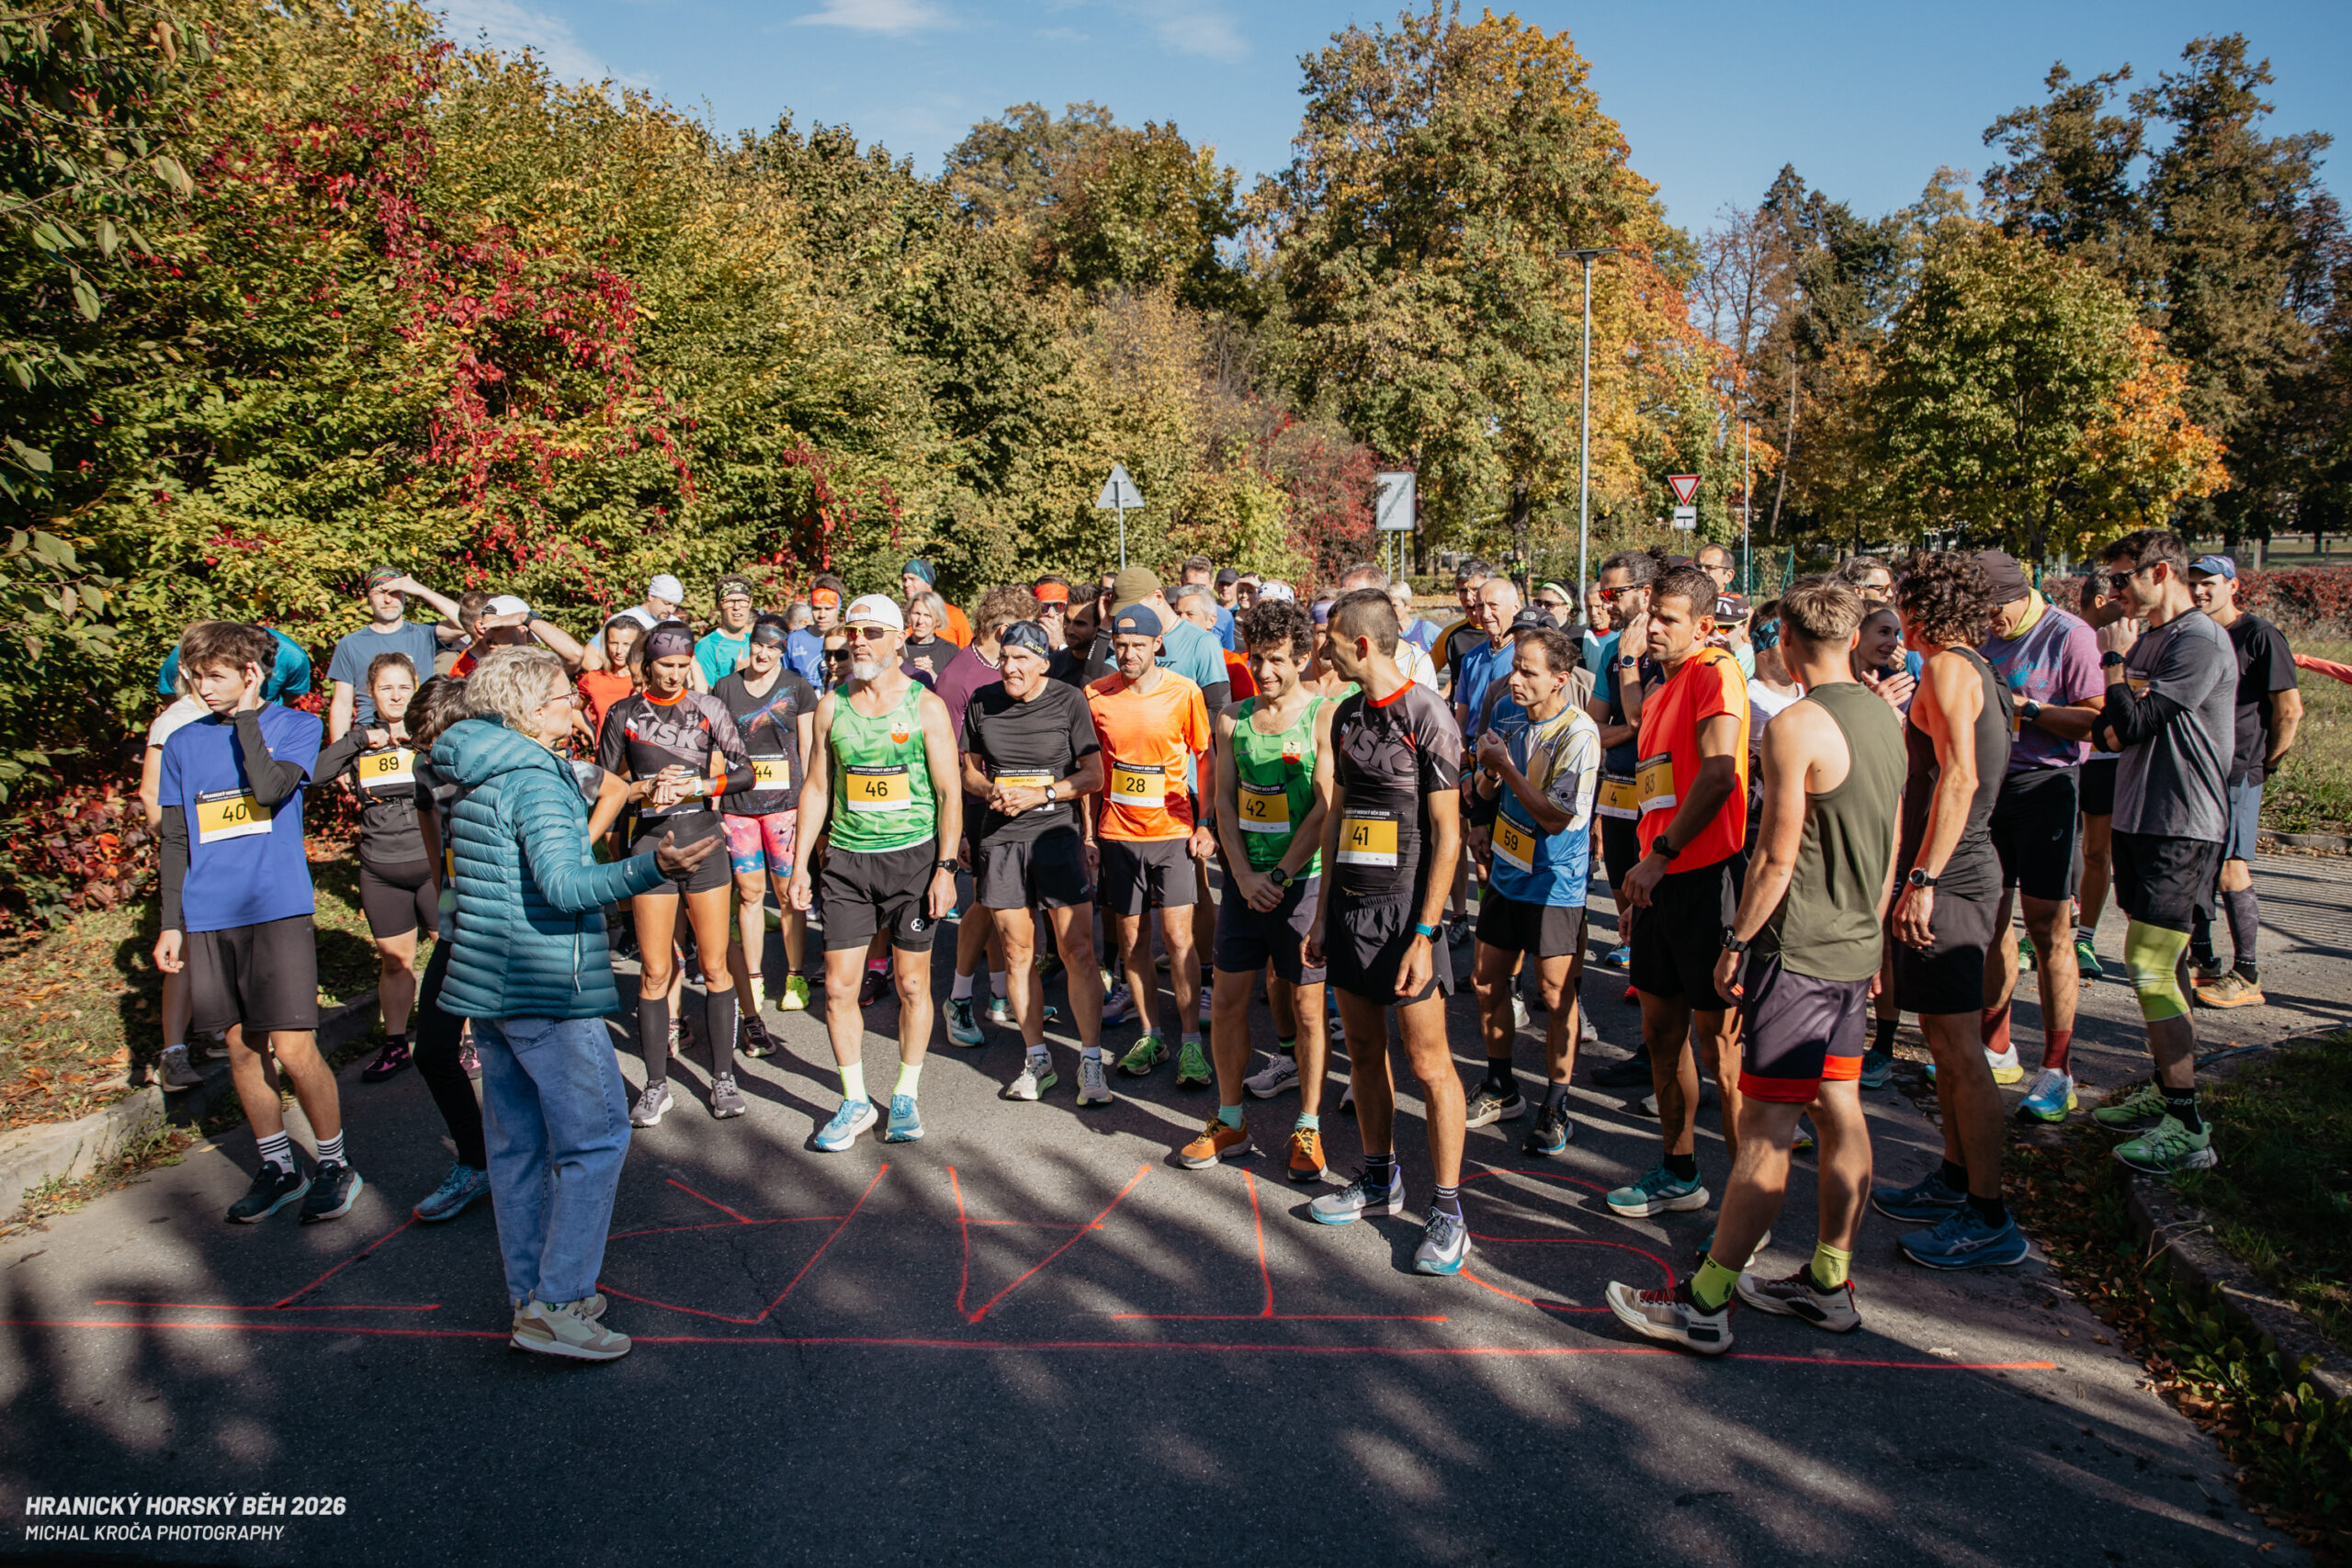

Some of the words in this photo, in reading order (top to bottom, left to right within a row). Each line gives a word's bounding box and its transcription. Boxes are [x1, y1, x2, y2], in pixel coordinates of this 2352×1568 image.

[649, 632, 691, 654] VSK
[638, 718, 702, 751] VSK
[1342, 720, 1406, 774] VSK
[379, 756, 399, 772] 89
[754, 765, 772, 778] 44
[865, 781, 888, 797] 46
[1125, 777, 1146, 793] 28
[1645, 773, 1656, 795] 83
[1245, 798, 1267, 818] 42
[1610, 791, 1618, 805] 4
[221, 803, 247, 822] 40
[1352, 826, 1369, 846] 41
[1504, 829, 1519, 852] 59
